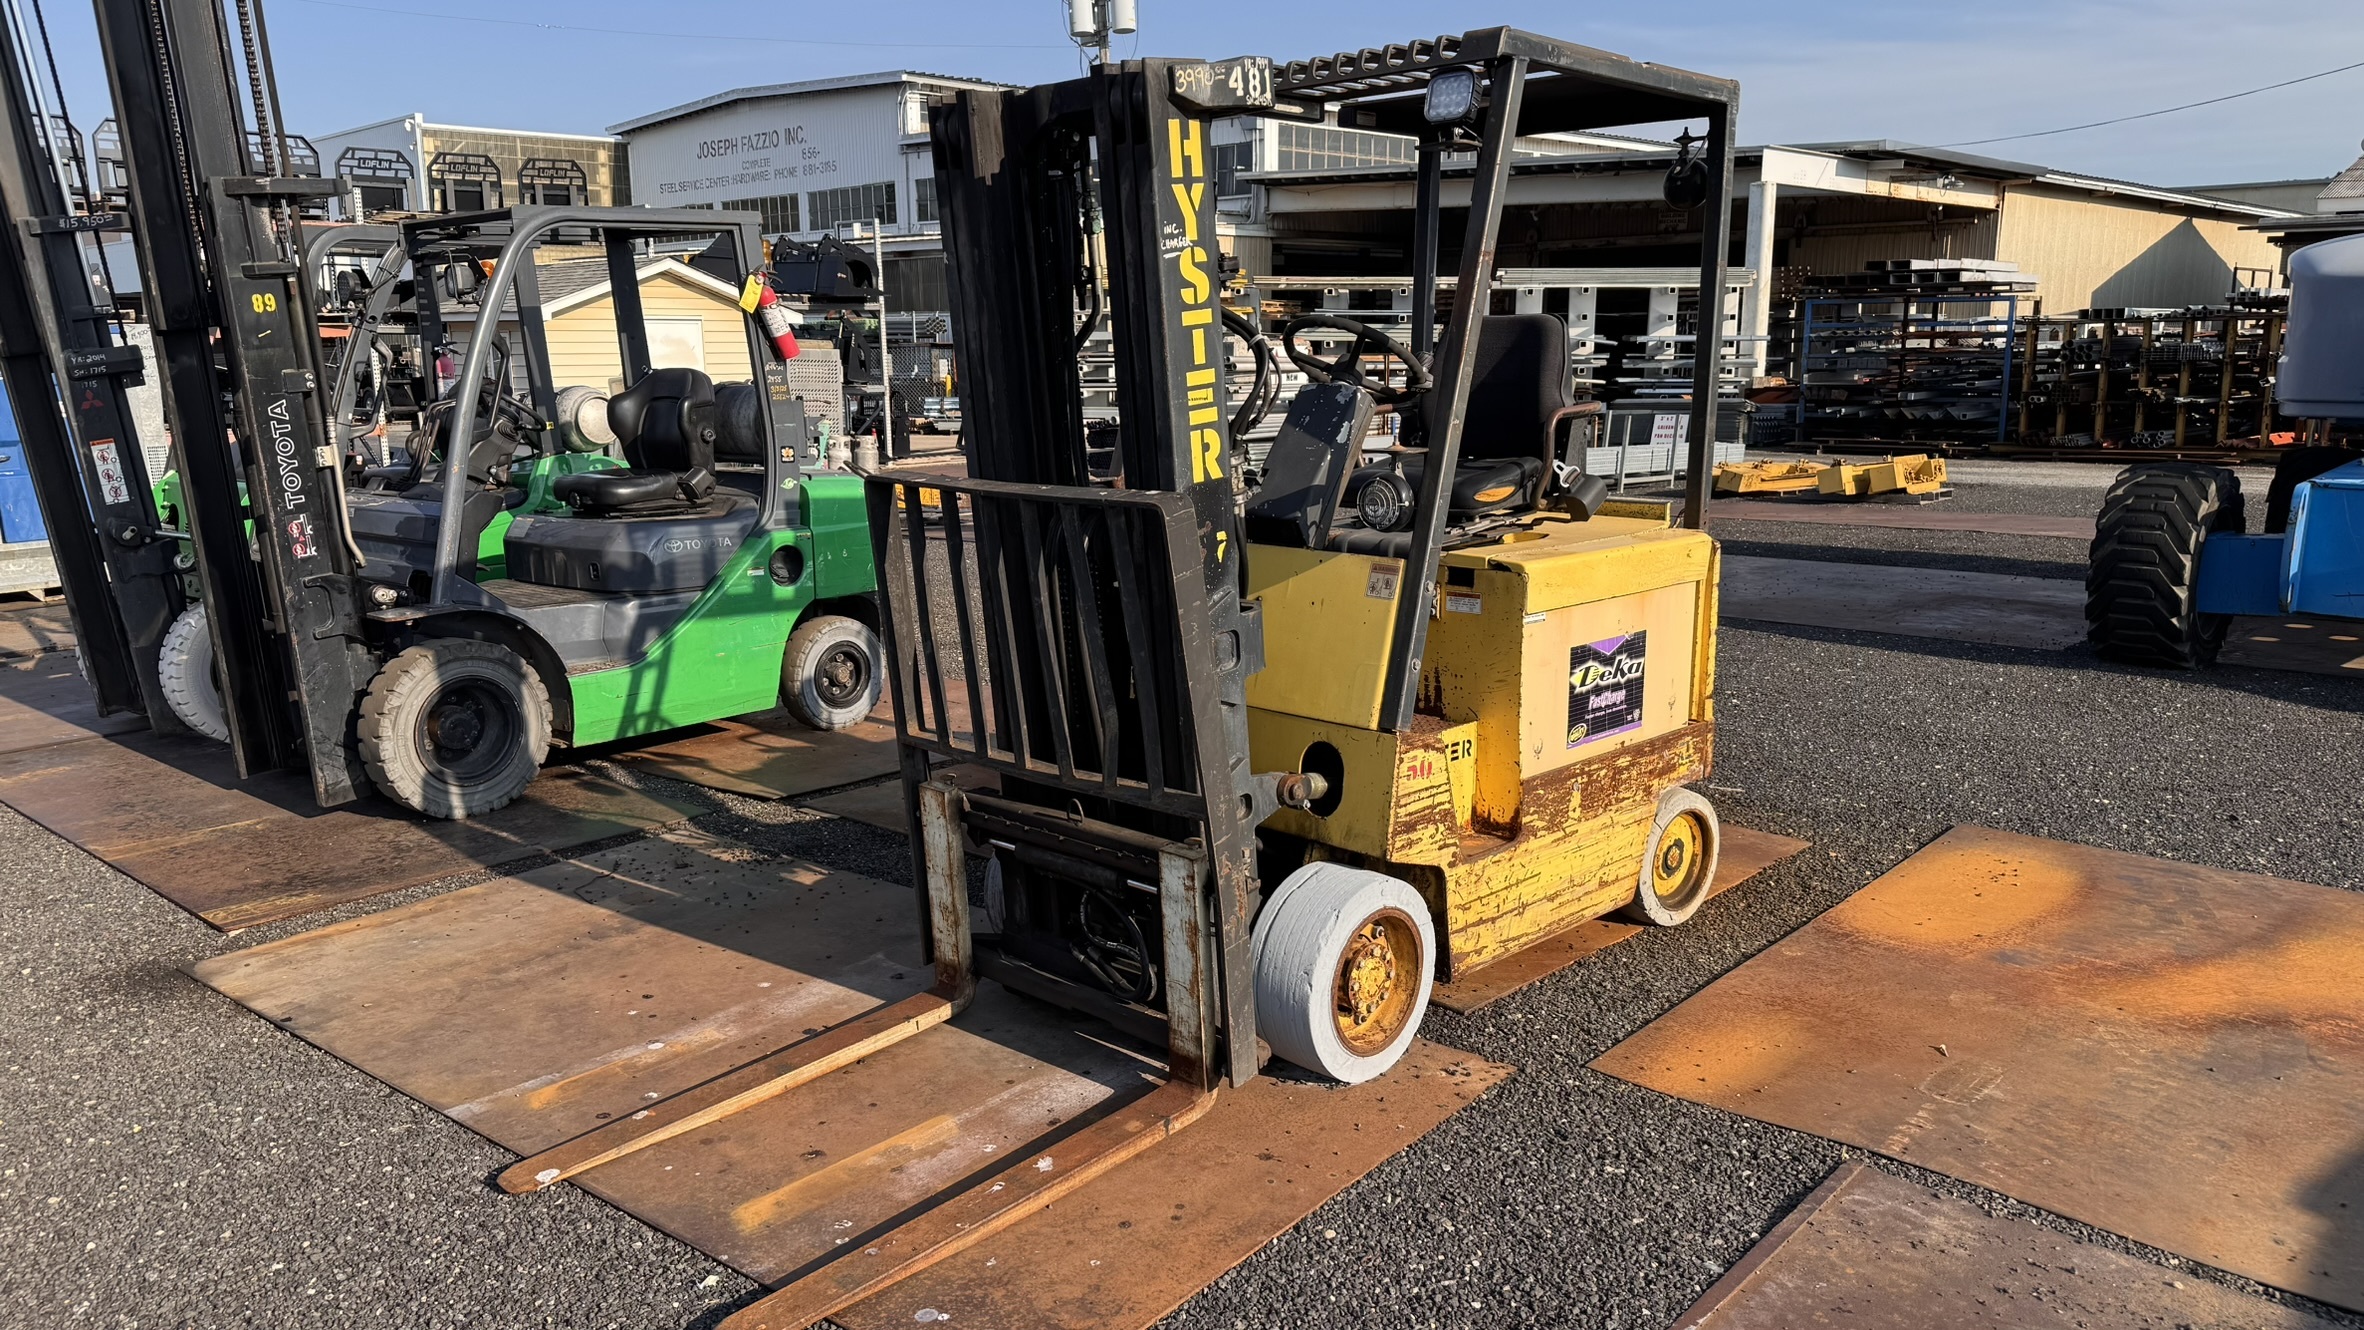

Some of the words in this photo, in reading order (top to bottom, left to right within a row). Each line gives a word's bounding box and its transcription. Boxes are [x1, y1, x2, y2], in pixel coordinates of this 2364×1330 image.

[1228, 65, 1272, 99] 481
[697, 137, 738, 159] JOSEPH
[741, 129, 779, 151] FAZZIO
[784, 124, 807, 146] INC.
[360, 158, 390, 169] LOFLIN
[450, 163, 479, 173] LOFLIN
[659, 181, 679, 194] STEEL
[678, 178, 704, 193] SERVICE
[705, 175, 730, 190] CENTER
[774, 165, 798, 180] PHONE
[251, 292, 277, 314] 89
[1167, 118, 1224, 485] HYSTER
[267, 399, 305, 510] TOYOTA
[684, 536, 732, 550] TOYOTA
[1578, 656, 1643, 689] Deka
[1588, 688, 1626, 710] FastCharge
